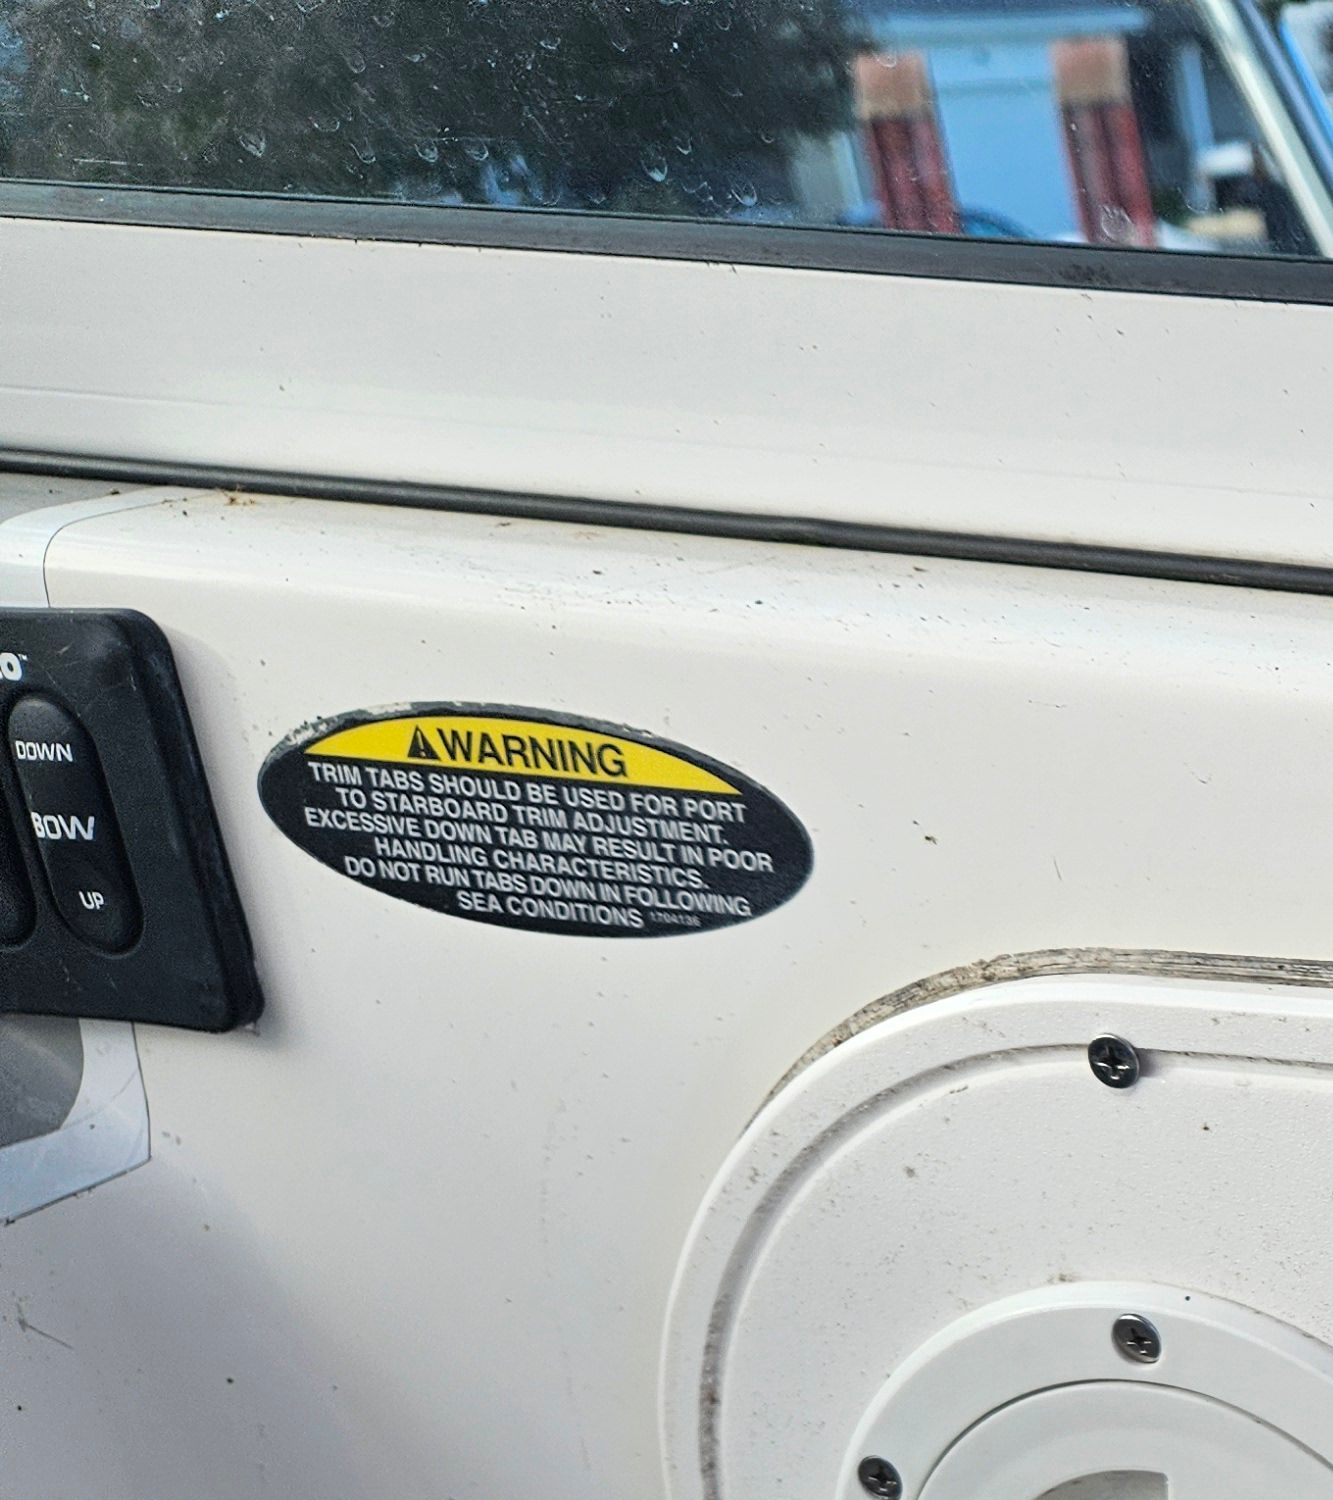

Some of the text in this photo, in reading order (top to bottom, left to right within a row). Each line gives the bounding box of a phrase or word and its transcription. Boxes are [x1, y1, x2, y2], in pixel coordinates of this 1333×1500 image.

[15, 739, 74, 763] DOWN
[436, 726, 629, 779] WARNING
[308, 762, 747, 822] TRIM TABS SHOULD BE USED FOR PORT
[336, 788, 728, 847] TO STARBOARD TRIM ADJUSTMENT.
[30, 811, 95, 841] BOW
[304, 807, 774, 872] EXCESSIVE DOWN TAB MAY RESULT IN POOR
[345, 856, 752, 916] DO NOT RUN TABS DOWN IN FOLLOWING
[374, 837, 710, 889] HANDLING CHARACTERISTICS.
[79, 890, 106, 911] UP
[458, 890, 504, 914] SEA
[507, 896, 644, 928] CONDITIONS
